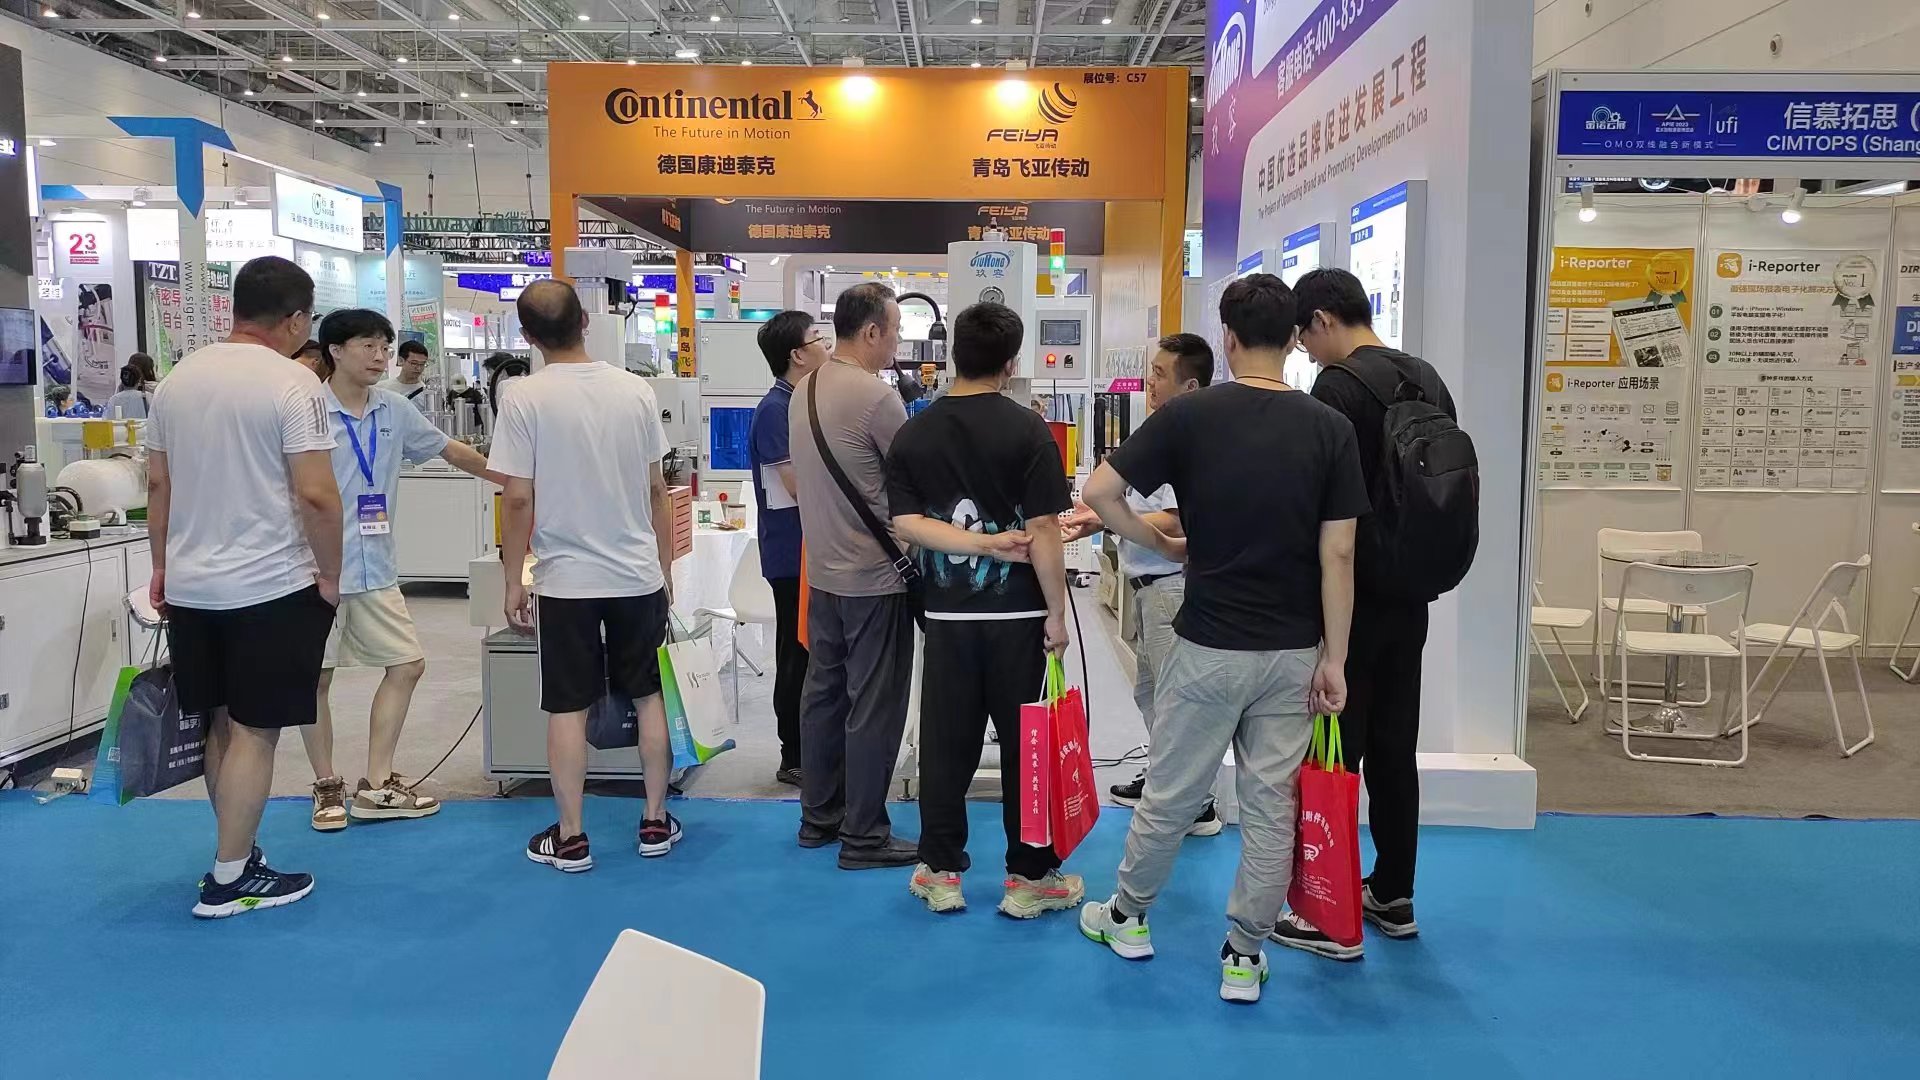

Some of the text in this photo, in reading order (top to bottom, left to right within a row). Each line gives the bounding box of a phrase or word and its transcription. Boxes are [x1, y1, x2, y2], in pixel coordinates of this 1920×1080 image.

[605, 87, 792, 124] Continental
[1258, 35, 1427, 198] 中国优选品牌促进发展工程
[653, 126, 791, 140] The Future in Motion
[1715, 116, 1739, 134] ufi
[1304, 172, 1317, 194] Brand
[1317, 166, 1326, 186] and
[1328, 152, 1355, 180] Promoting
[1407, 107, 1428, 133] China
[1766, 135, 1857, 151] CIMTOPS
[657, 154, 776, 176] 德国康迪泰克
[972, 157, 1090, 178] 青岛飞亚传动
[745, 204, 842, 214] The Future in Motion
[748, 223, 832, 238] 德国康迪泰克
[1560, 255, 1633, 270] i-Reporter
[1748, 260, 1821, 274] i-Reporter
[1567, 376, 1660, 390] i-Reporter 应用场景
